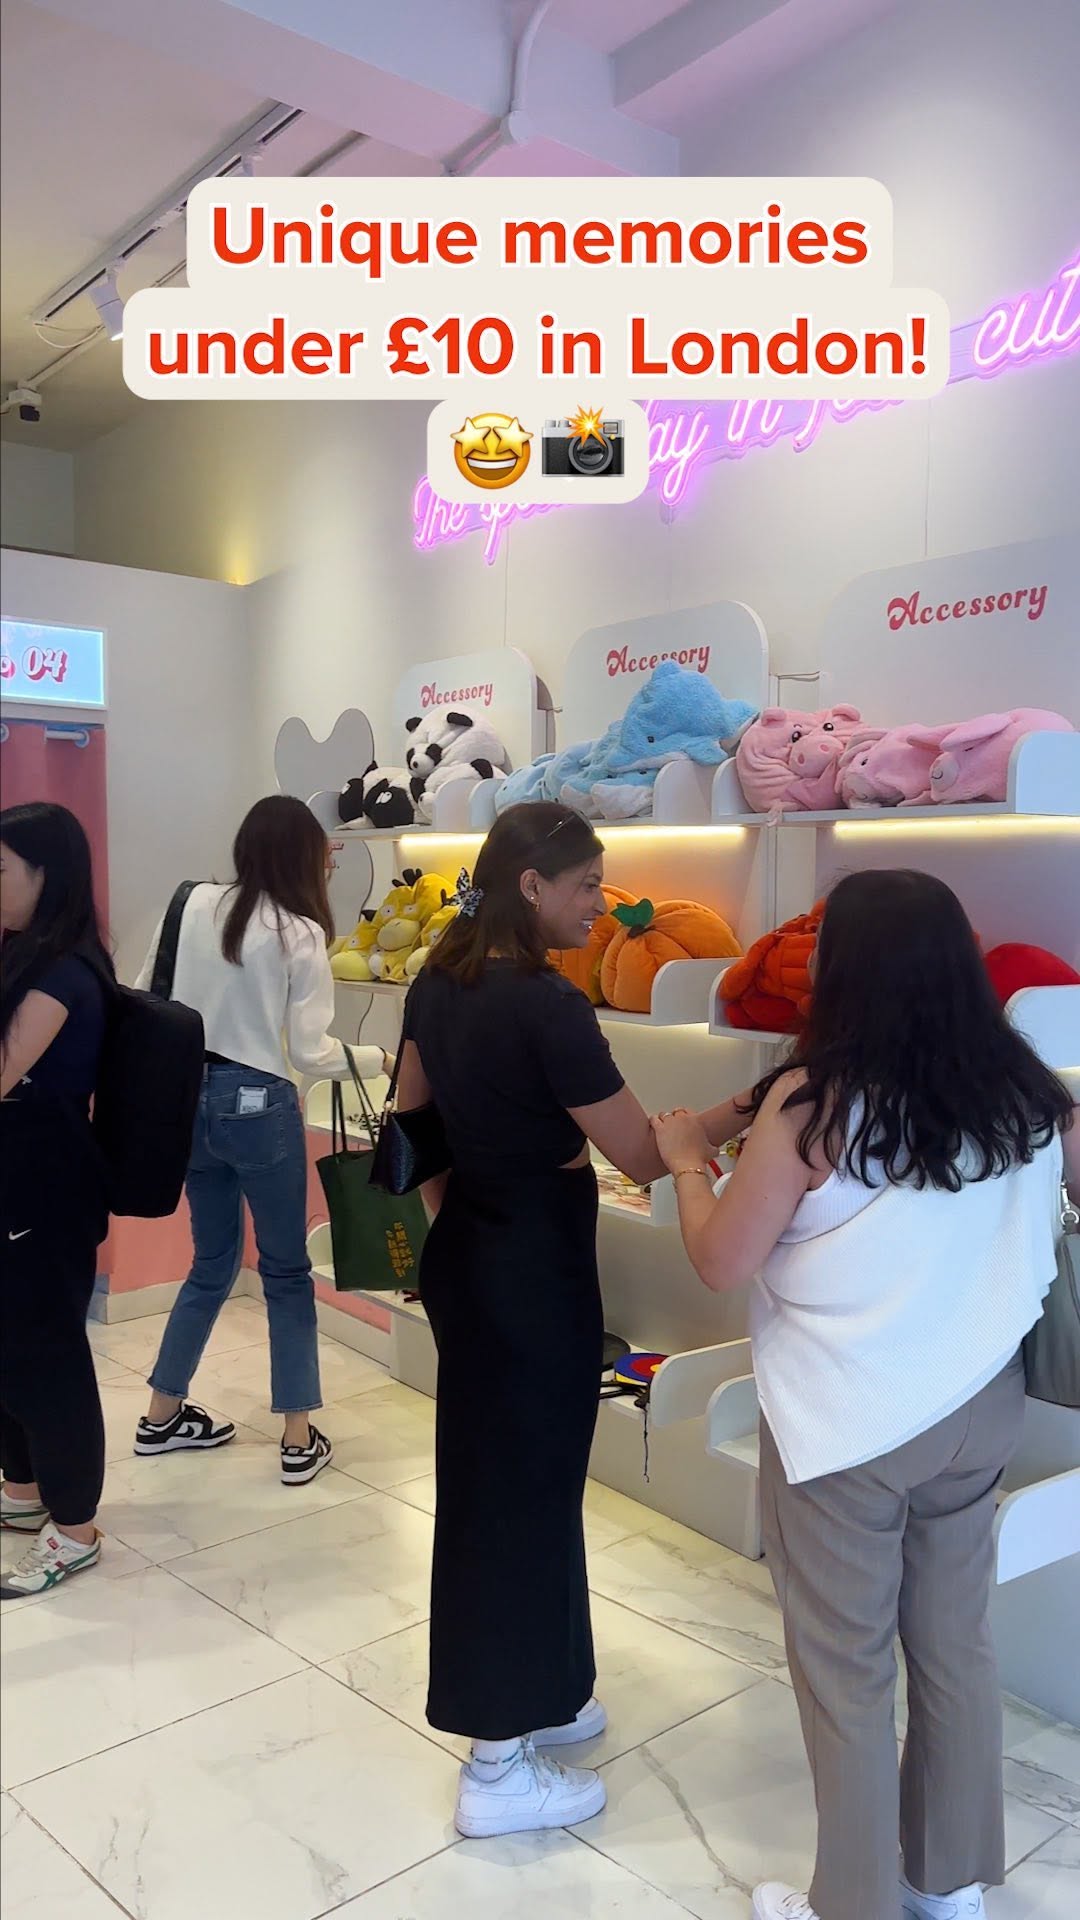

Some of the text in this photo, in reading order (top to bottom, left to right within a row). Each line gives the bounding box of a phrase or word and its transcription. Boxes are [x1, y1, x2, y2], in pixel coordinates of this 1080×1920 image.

[645, 400, 711, 499] ay
[887, 585, 1048, 631] Accessory
[22, 646, 67, 683] 04
[420, 681, 494, 708] Accessory
